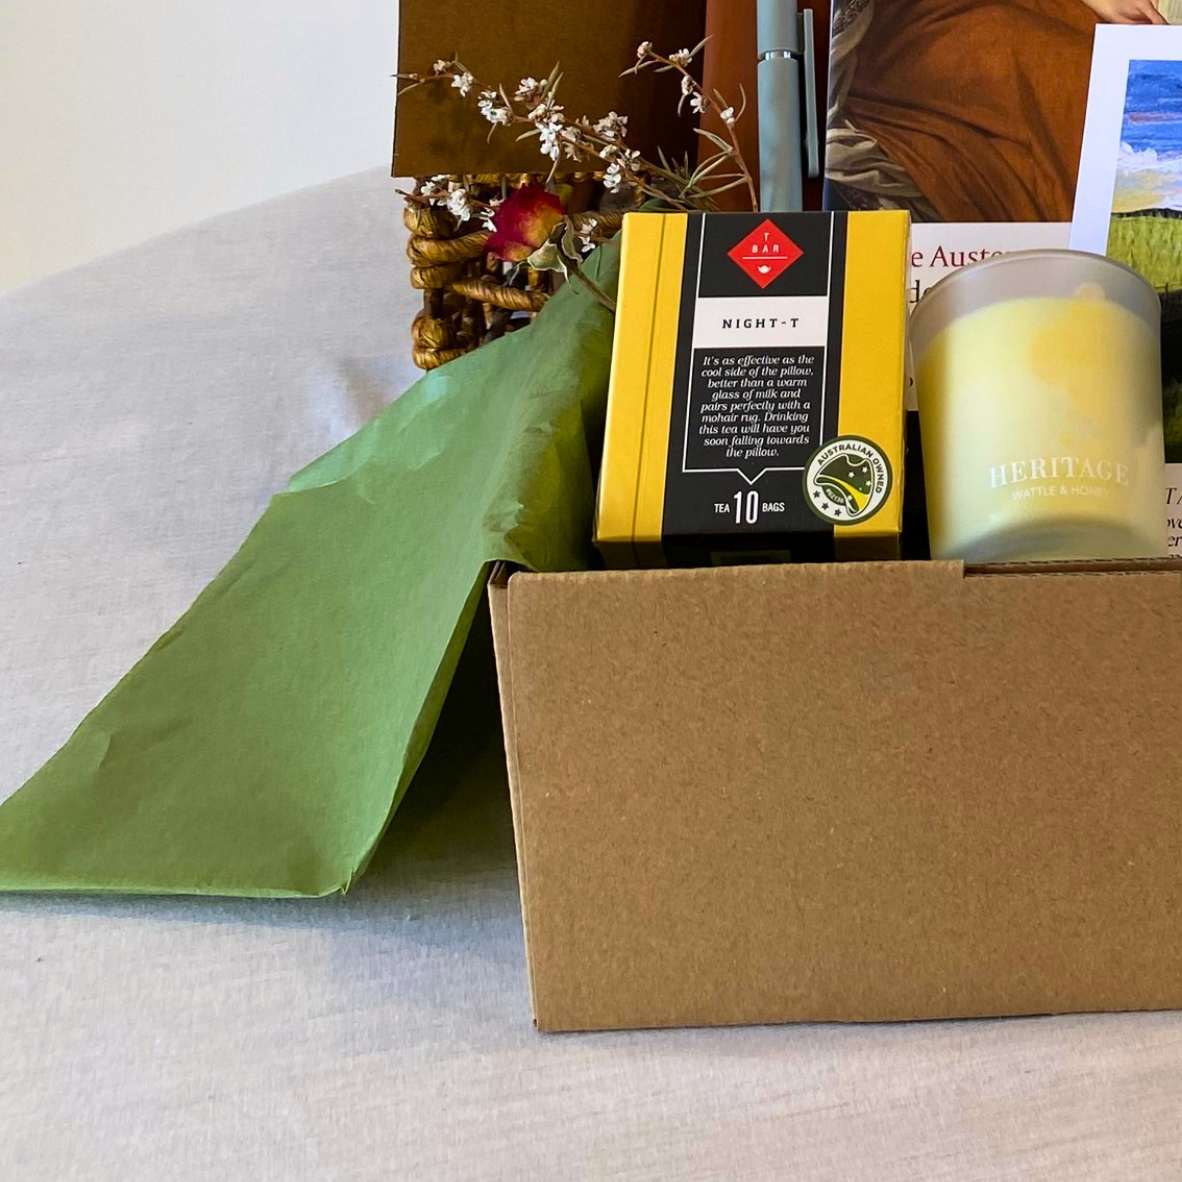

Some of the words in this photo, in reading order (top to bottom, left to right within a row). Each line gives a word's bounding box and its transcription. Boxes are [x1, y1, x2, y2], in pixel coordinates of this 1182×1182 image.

[764, 232, 770, 242] T
[752, 244, 779, 253] BAR
[722, 318, 799, 329] NIGHT-T
[703, 356, 720, 366] It's
[722, 357, 735, 366] as
[738, 355, 780, 367] effective
[782, 356, 795, 365] as
[797, 354, 815, 364] the
[701, 367, 722, 377] cool
[724, 367, 747, 377] side
[748, 366, 760, 378] of
[761, 366, 778, 376] the
[707, 378, 738, 388] better
[740, 378, 764, 388] than
[777, 379, 808, 387] warm
[711, 389, 740, 402] glass
[742, 388, 755, 401] of
[755, 388, 778, 399] milk
[780, 388, 801, 398] and
[700, 402, 728, 413] pairs
[730, 400, 775, 412] perfectly
[777, 400, 801, 410] with
[803, 401, 811, 409] a
[701, 413, 738, 423] mohair
[740, 414, 761, 425] rug.
[764, 411, 809, 423] Drinking
[699, 425, 719, 435] this
[721, 425, 738, 434] tea
[740, 423, 760, 433] will
[762, 424, 788, 433] have
[790, 425, 810, 435] you
[703, 438, 728, 446] soon
[729, 435, 764, 448] falling
[766, 434, 810, 445] towards
[726, 448, 743, 457] the
[744, 446, 780, 459] pillow.
[817, 443, 874, 465] AUSTRALIAN
[872, 458, 884, 494] OWNED
[989, 456, 1130, 489] HERITAGE
[1011, 485, 1056, 500] WATTLE
[1060, 485, 1068, 495] &
[1071, 486, 1110, 497] HONEY
[714, 503, 730, 513] TEA
[733, 490, 759, 524] 10
[762, 502, 785, 513] BAGS
